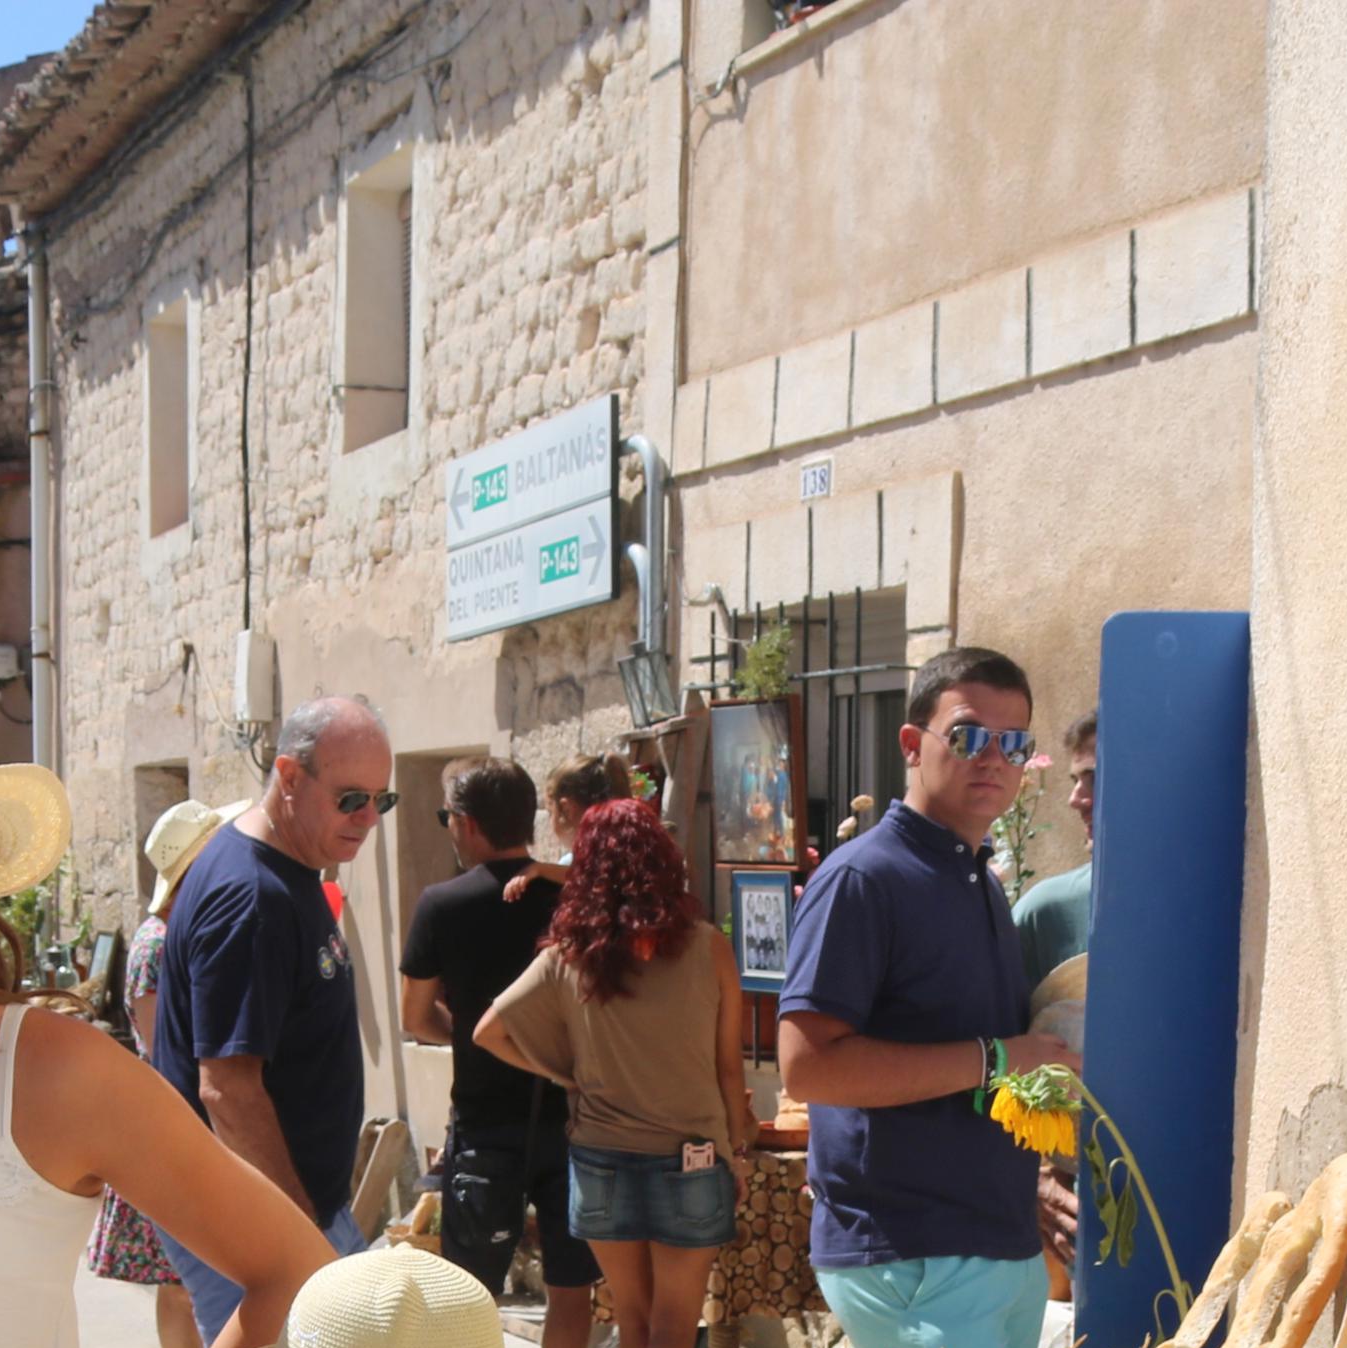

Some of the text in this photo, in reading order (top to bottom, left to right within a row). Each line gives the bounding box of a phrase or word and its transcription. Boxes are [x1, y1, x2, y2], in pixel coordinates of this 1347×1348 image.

[473, 424, 606, 508] P-143 BALTANÁS
[803, 468, 827, 496] 138
[449, 536, 524, 586] QUINTANA
[541, 541, 578, 579] P-143
[448, 581, 519, 622] DEL PUENTE
